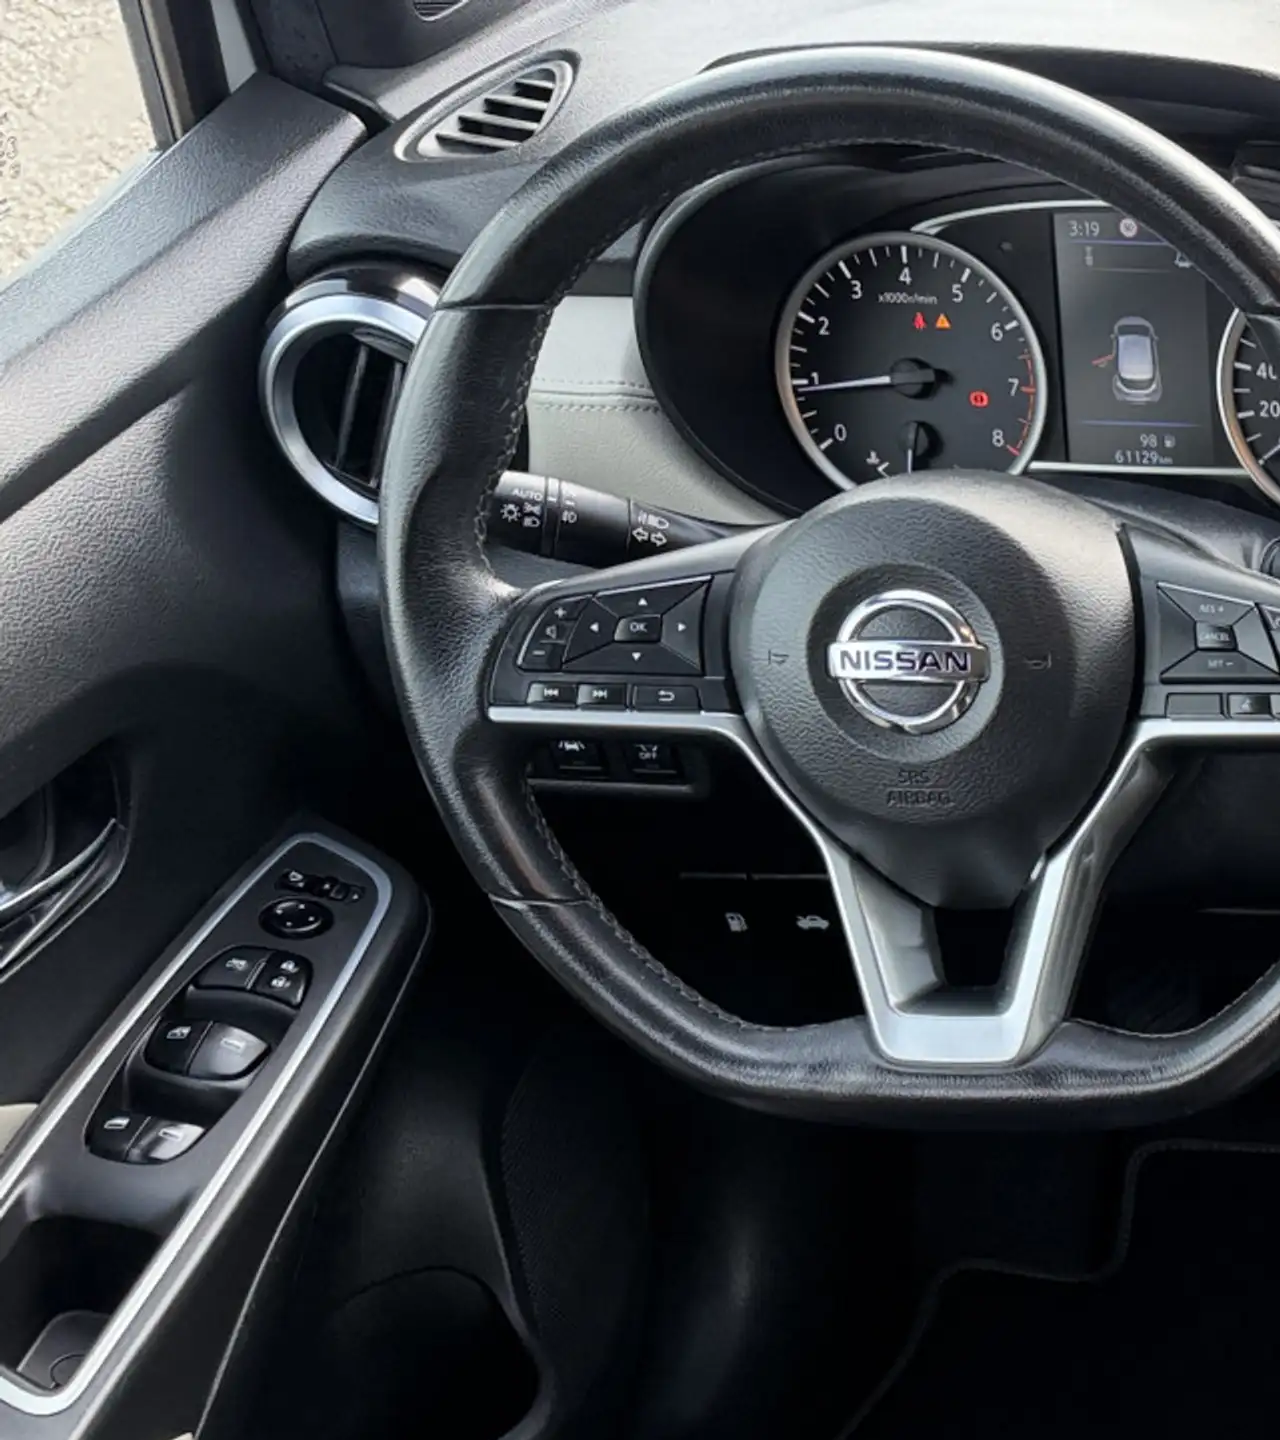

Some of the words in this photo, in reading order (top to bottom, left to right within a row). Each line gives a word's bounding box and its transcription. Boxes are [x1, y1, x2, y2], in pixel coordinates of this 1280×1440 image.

[1069, 221, 1099, 237] 3:19
[900, 268, 911, 284] 4
[850, 281, 862, 299] 3
[952, 285, 963, 302] 5
[819, 318, 830, 335] 2
[991, 324, 1003, 340] 6
[1008, 379, 1018, 396] 7
[1260, 401, 1280, 416] 20
[835, 424, 847, 441] 0
[992, 430, 1004, 447] 8
[1140, 435, 1157, 447] 98
[512, 488, 543, 501] AUTO
[630, 622, 647, 633] OK
[839, 650, 969, 672] NISSAN
